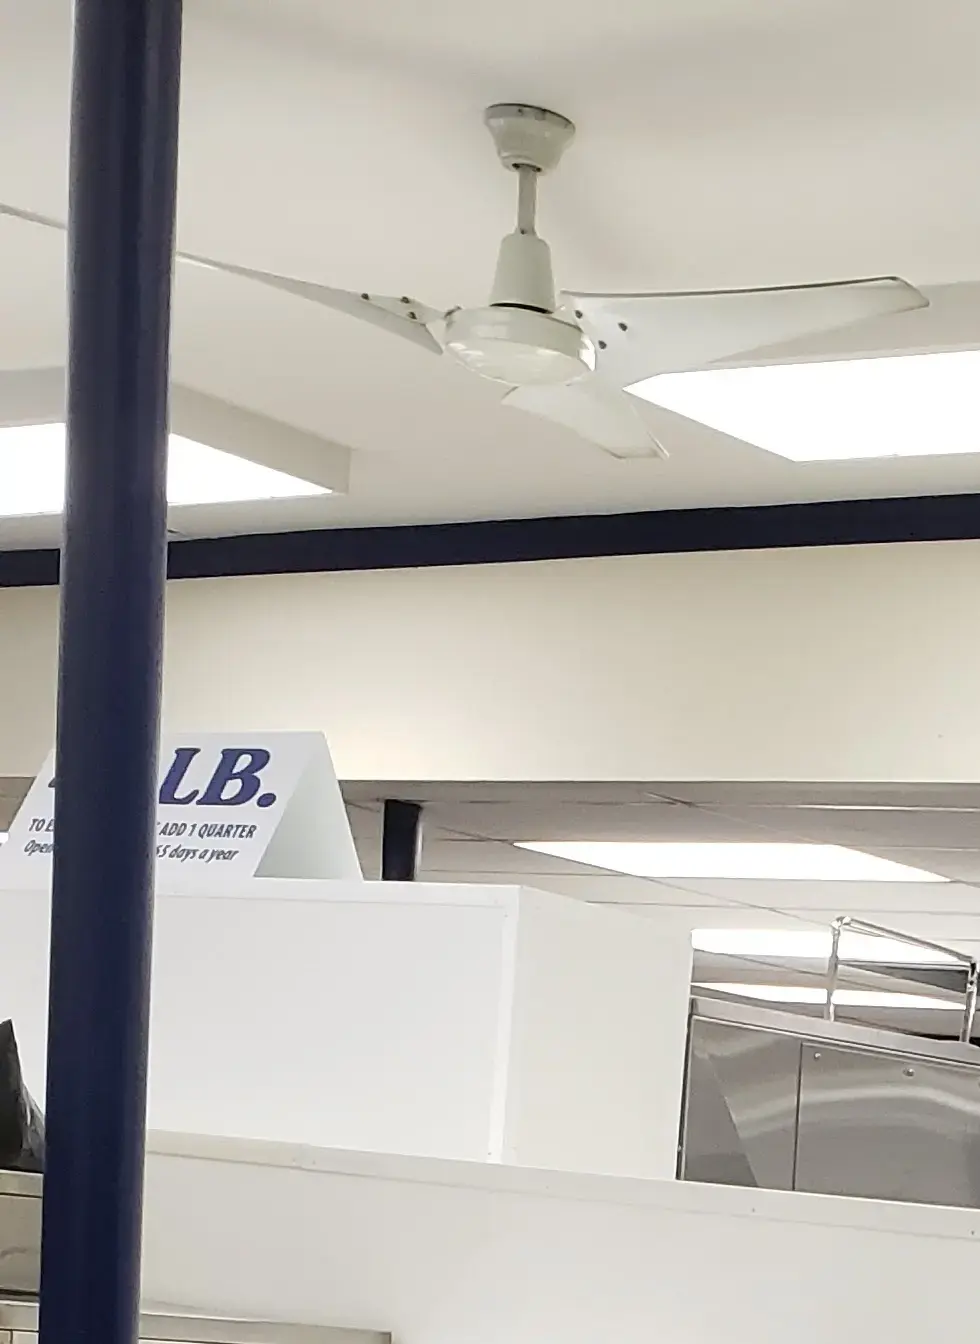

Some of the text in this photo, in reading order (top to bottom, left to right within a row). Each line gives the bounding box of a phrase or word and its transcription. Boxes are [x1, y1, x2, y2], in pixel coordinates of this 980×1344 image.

[159, 747, 277, 808] LB.
[28, 818, 45, 832] TO
[158, 822, 257, 839] ADD 1 QUARTER
[168, 844, 199, 863] days
[205, 849, 239, 862] year
